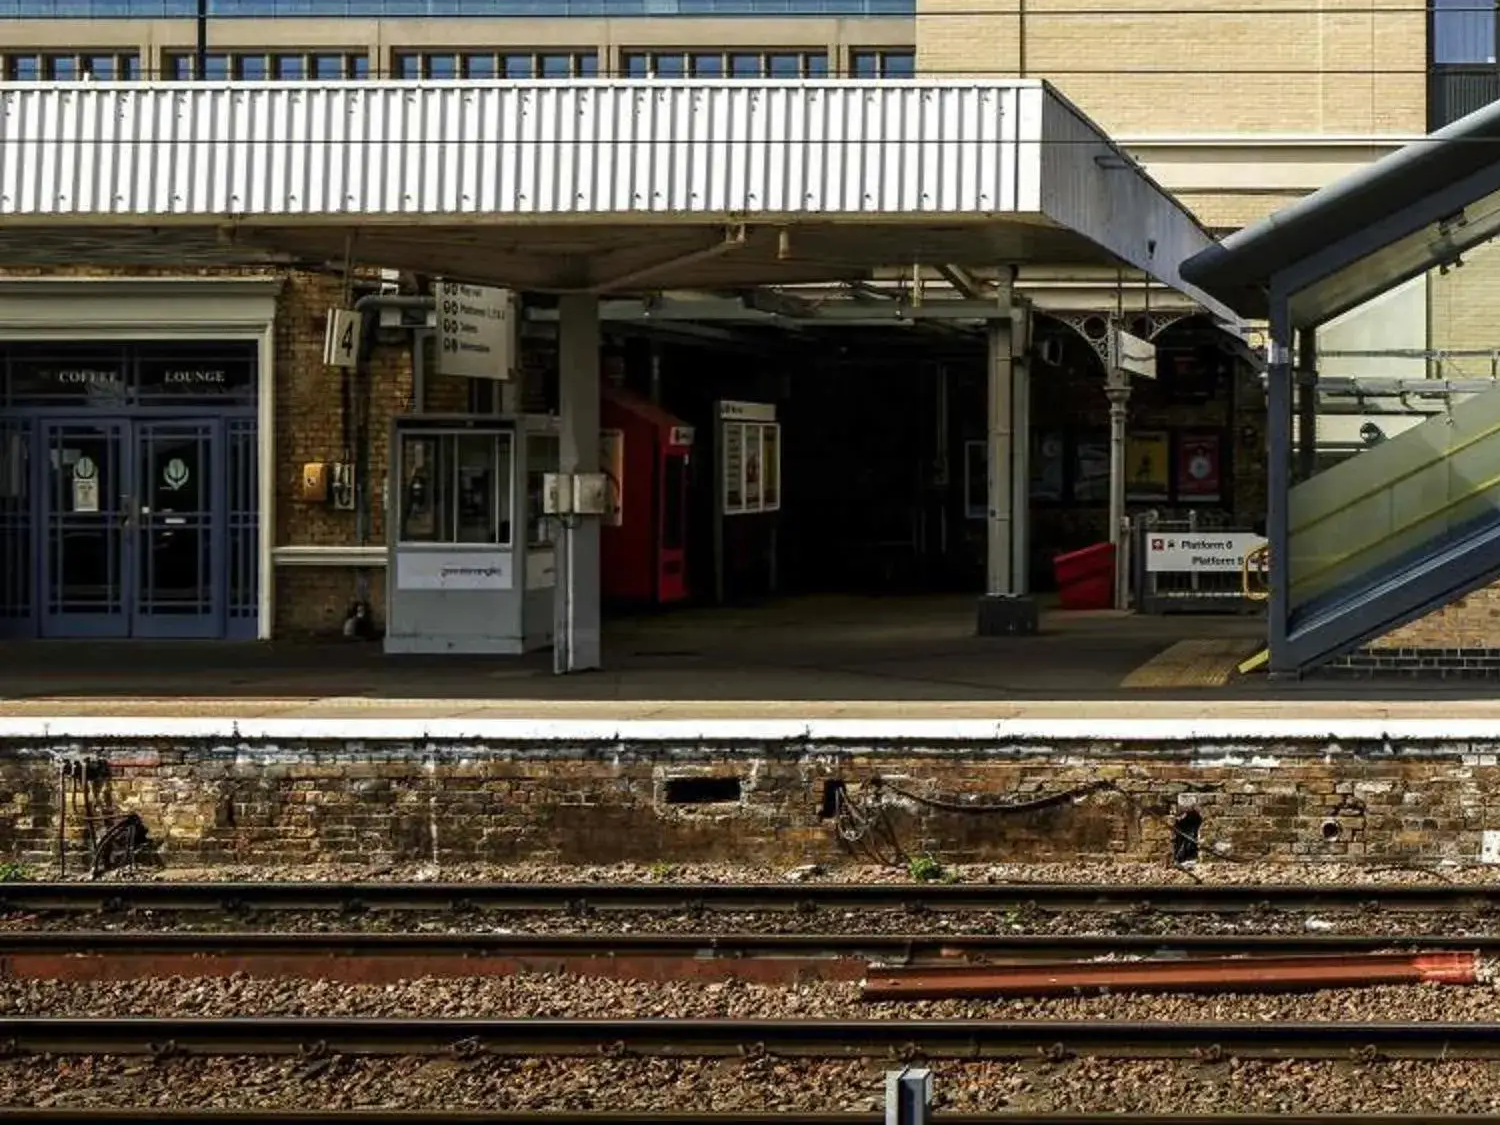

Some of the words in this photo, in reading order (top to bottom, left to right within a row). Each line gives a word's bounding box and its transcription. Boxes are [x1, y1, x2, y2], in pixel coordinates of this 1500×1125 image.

[341, 320, 353, 358] 4
[164, 370, 225, 383] LOUNGE
[1181, 540, 1224, 550] Platform
[1192, 556, 1235, 565] Platform
